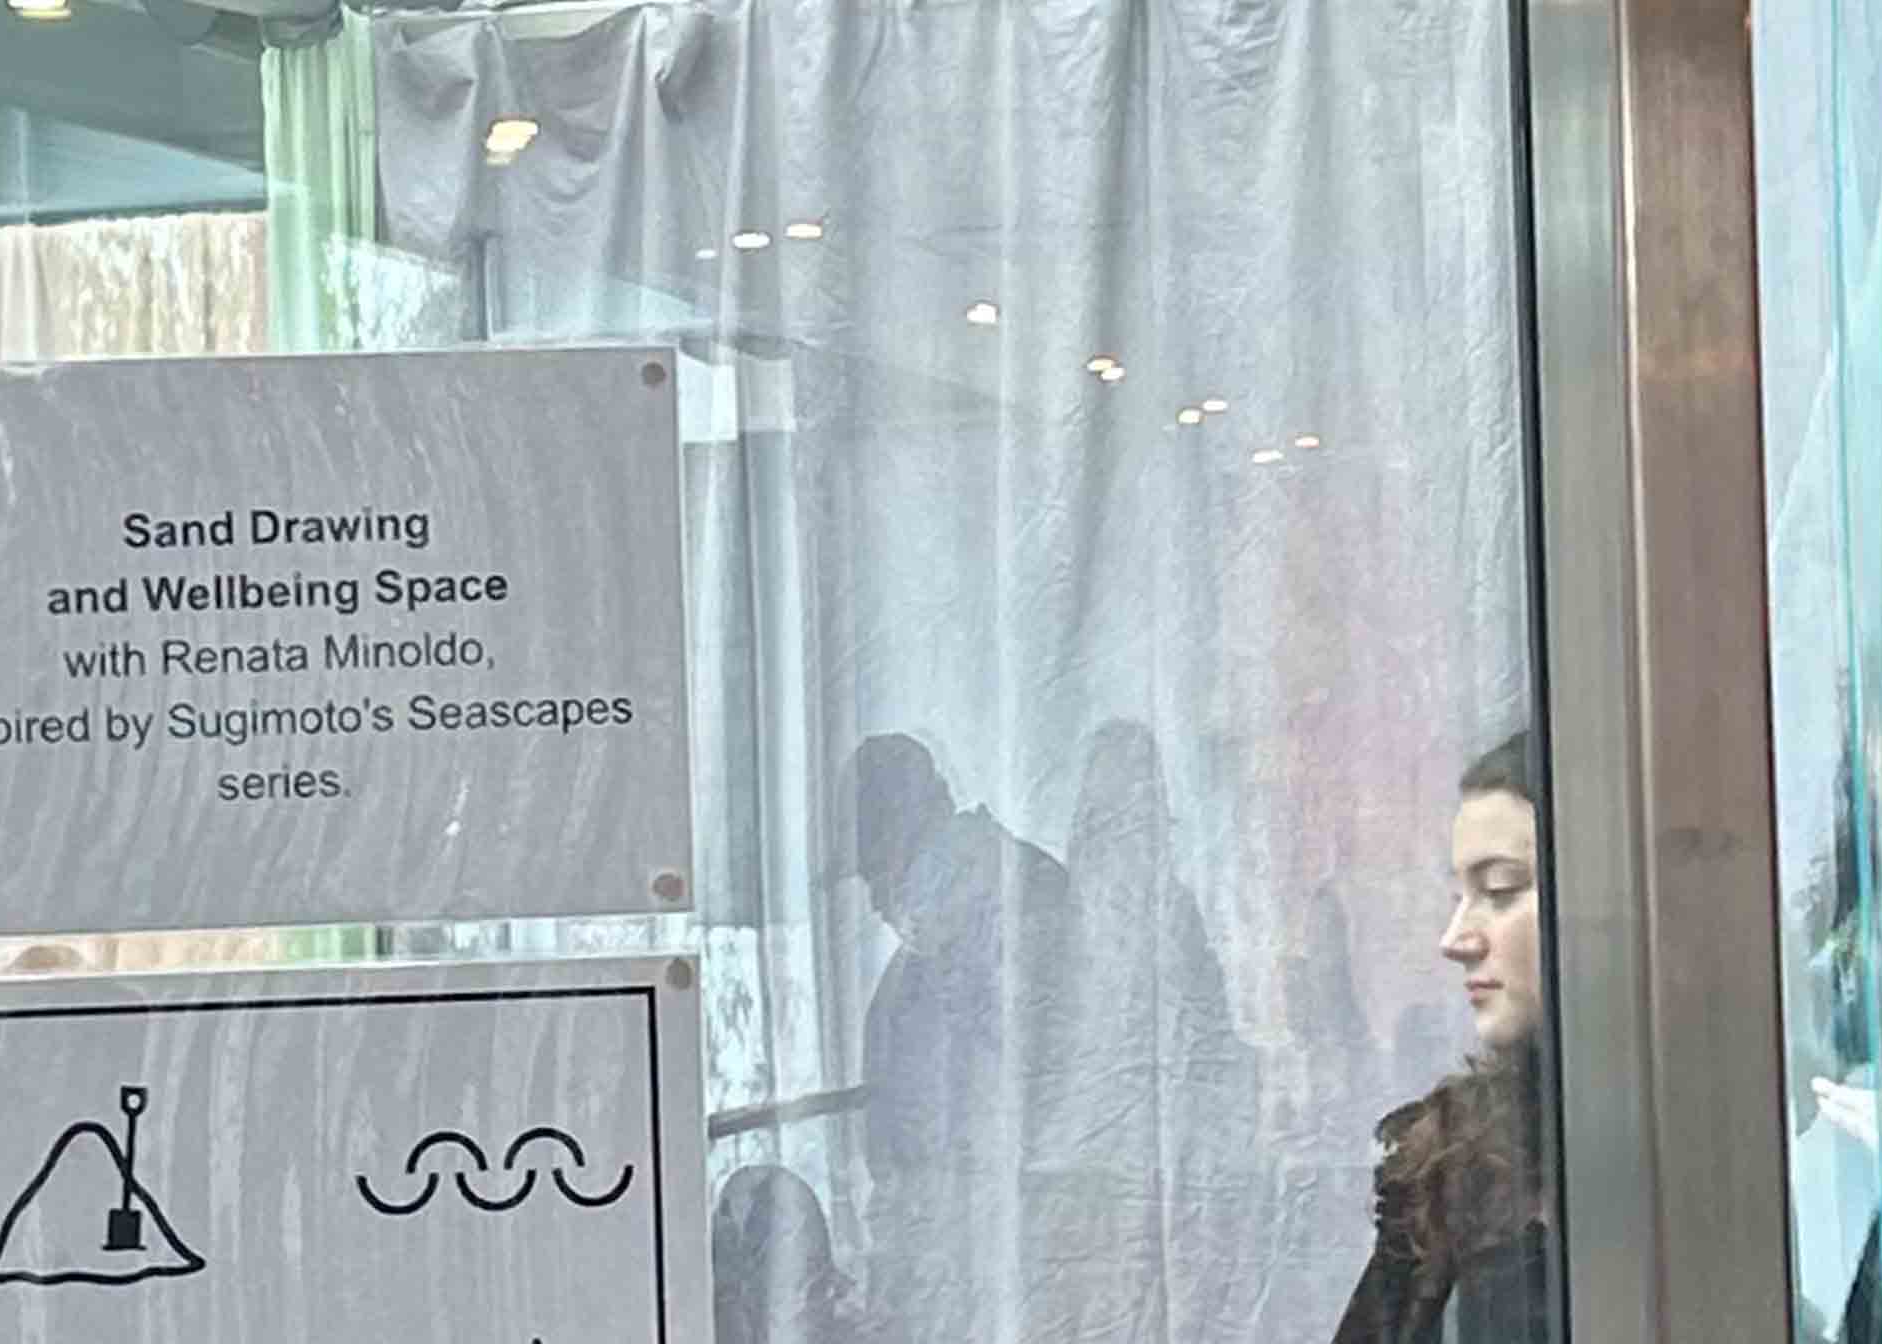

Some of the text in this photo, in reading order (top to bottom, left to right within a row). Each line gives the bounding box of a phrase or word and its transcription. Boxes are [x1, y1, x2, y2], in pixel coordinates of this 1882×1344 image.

[122, 505, 430, 549] Sand Drawing
[47, 568, 509, 614] and Wellbeing Space
[63, 631, 496, 678] with Renata Minoldo,
[105, 705, 153, 750] by
[168, 697, 395, 747] Sugimoto's
[407, 693, 633, 735] Seascapes
[217, 763, 352, 801] series.
